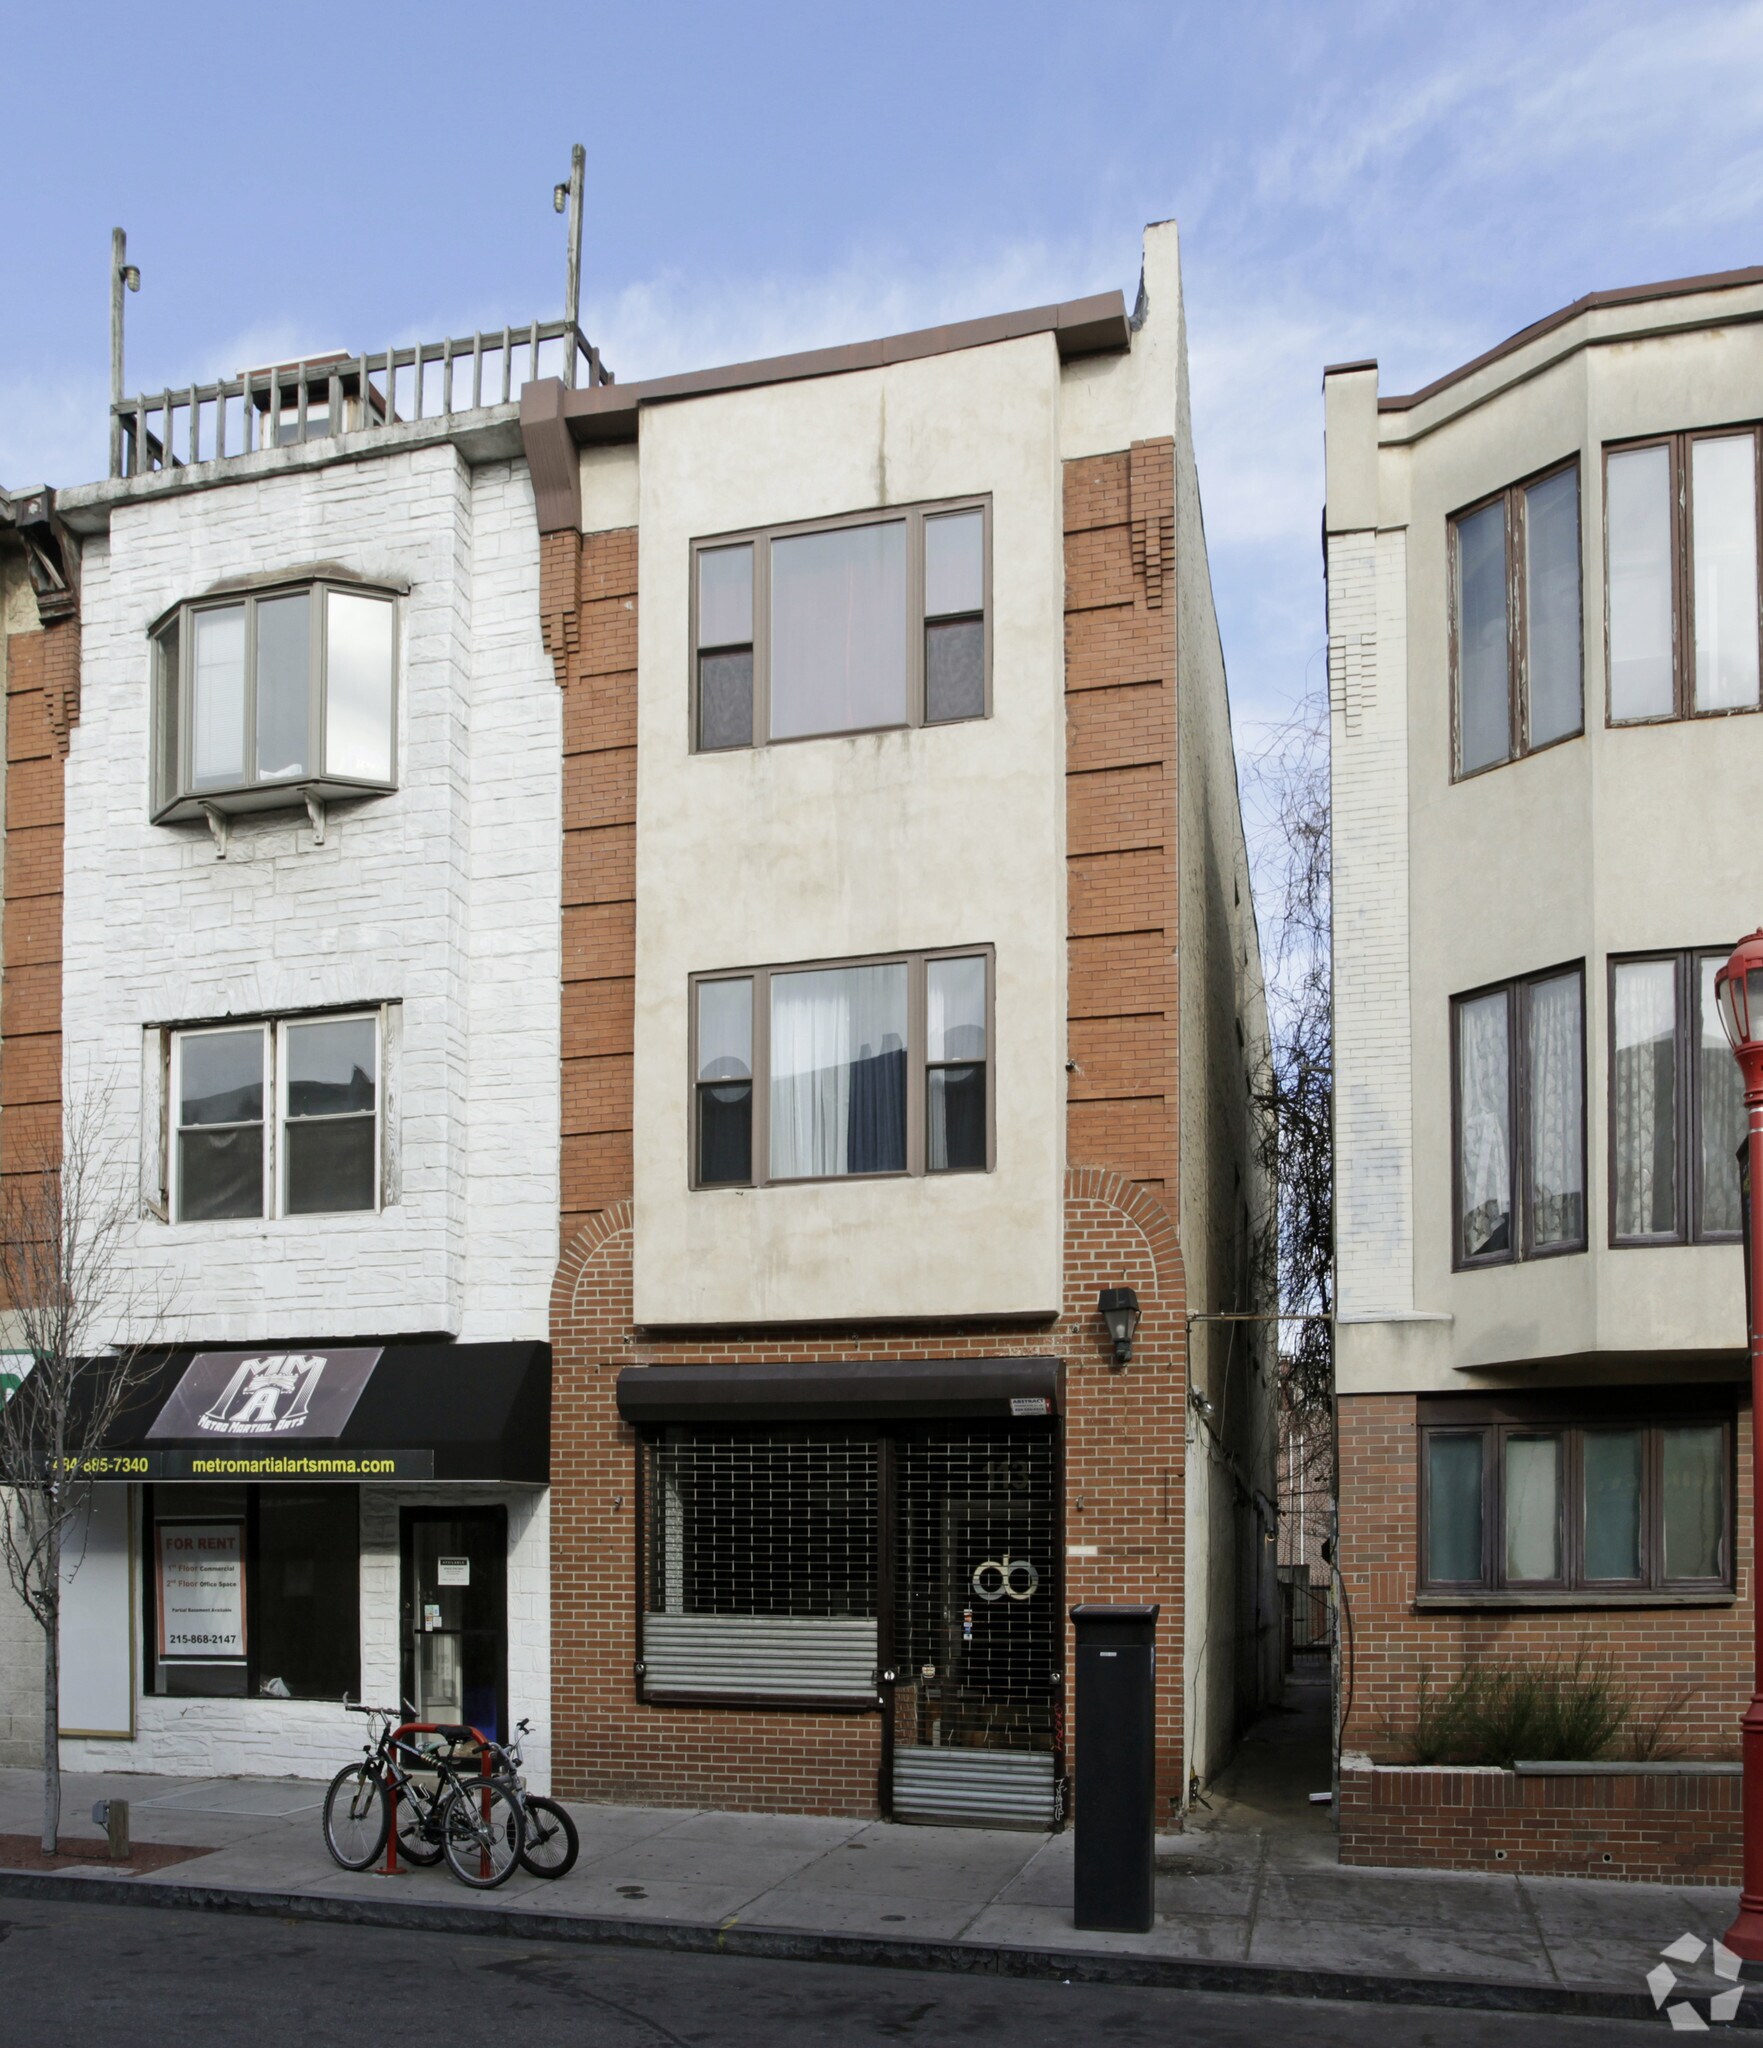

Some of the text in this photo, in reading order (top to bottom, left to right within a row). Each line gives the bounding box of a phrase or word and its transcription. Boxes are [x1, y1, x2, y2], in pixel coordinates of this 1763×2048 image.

[228, 1421, 272, 1434] MARTIAL
[274, 1416, 307, 1431] ARTS
[52, 1457, 149, 1473] 48485-7340
[192, 1456, 395, 1473] metromartialartsmma.com
[166, 1537, 235, 1550] FOR RENT
[178, 1564, 198, 1572] Floor
[178, 1580, 198, 1588] Floor
[169, 1634, 237, 1644] 215-868-2147
